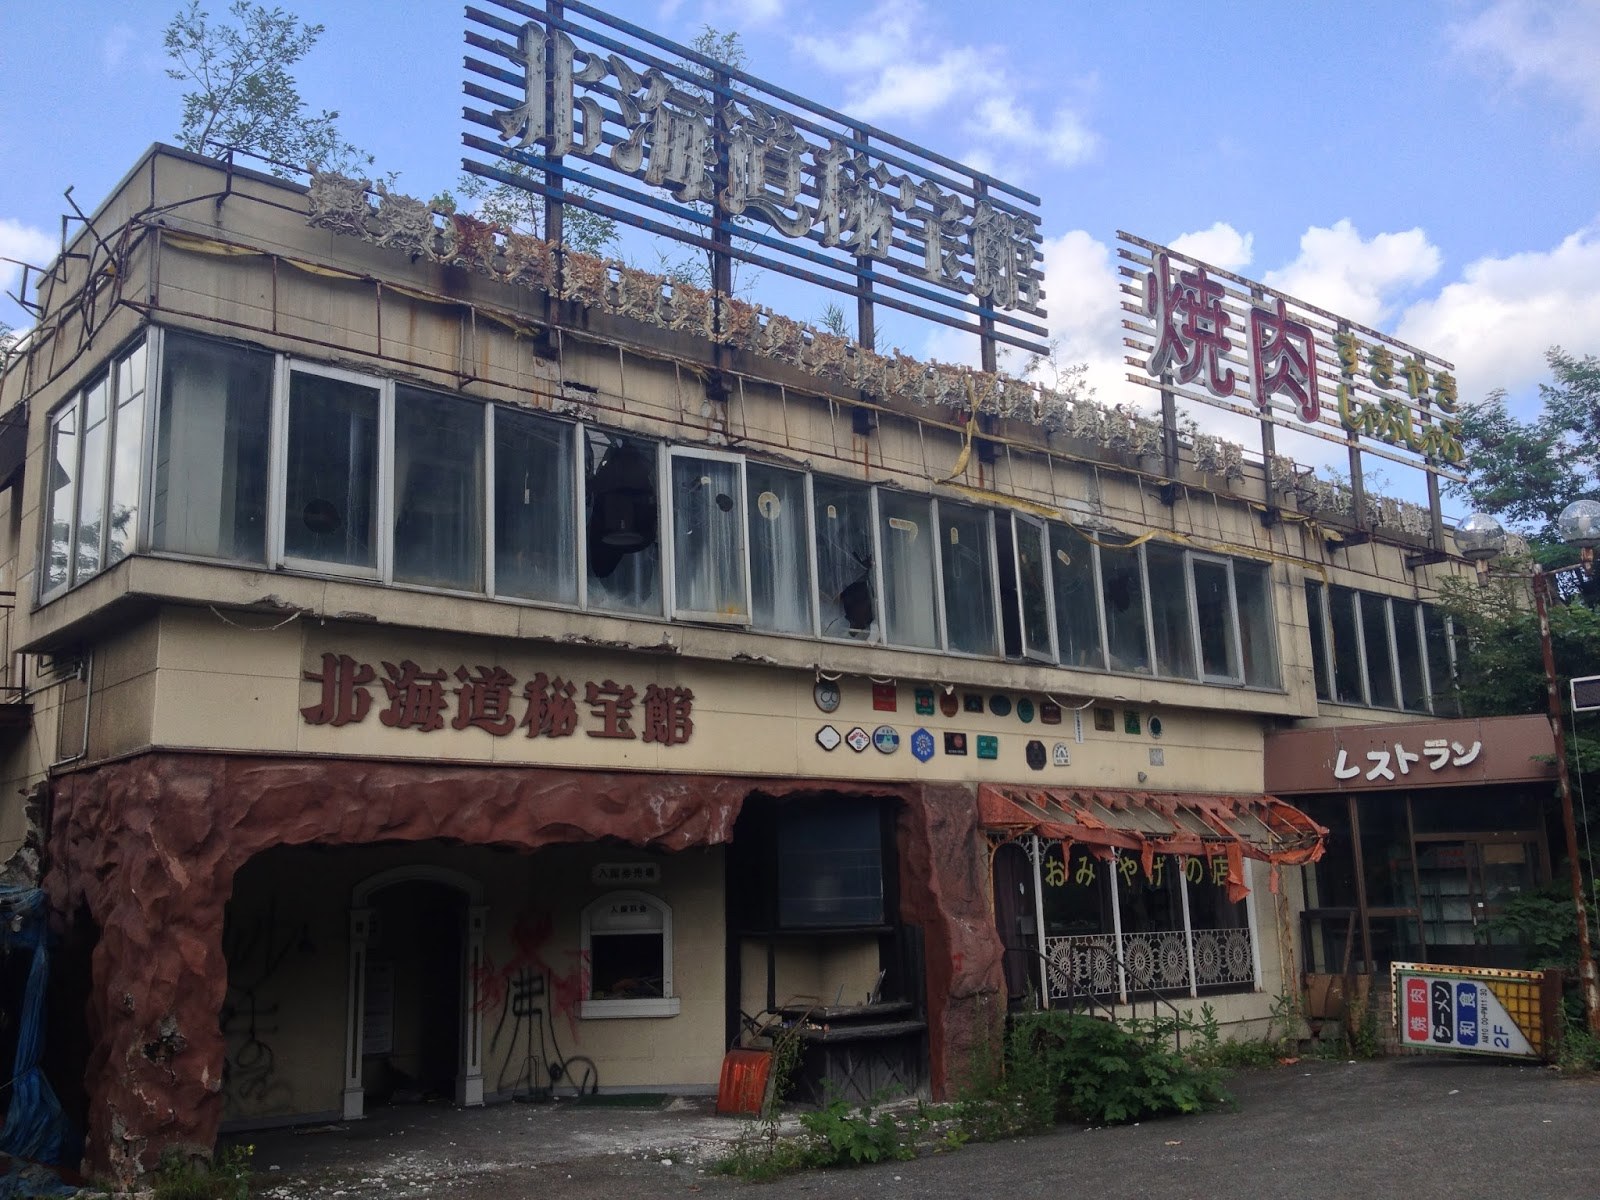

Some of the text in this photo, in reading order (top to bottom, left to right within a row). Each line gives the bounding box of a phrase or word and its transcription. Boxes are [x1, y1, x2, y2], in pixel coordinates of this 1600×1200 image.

[1142, 253, 1320, 423] 焼肉
[1333, 332, 1459, 413] すきやき
[1337, 383, 1465, 462] しゃぶしゃぶ
[300, 652, 695, 746] 北海道秘宝館
[1334, 740, 1481, 781] レストラン
[1410, 989, 1427, 1031] 焼肉
[1435, 986, 1450, 1038] ラーメン
[1459, 992, 1476, 1036] 和食
[1494, 1025, 1509, 1048] 2F
